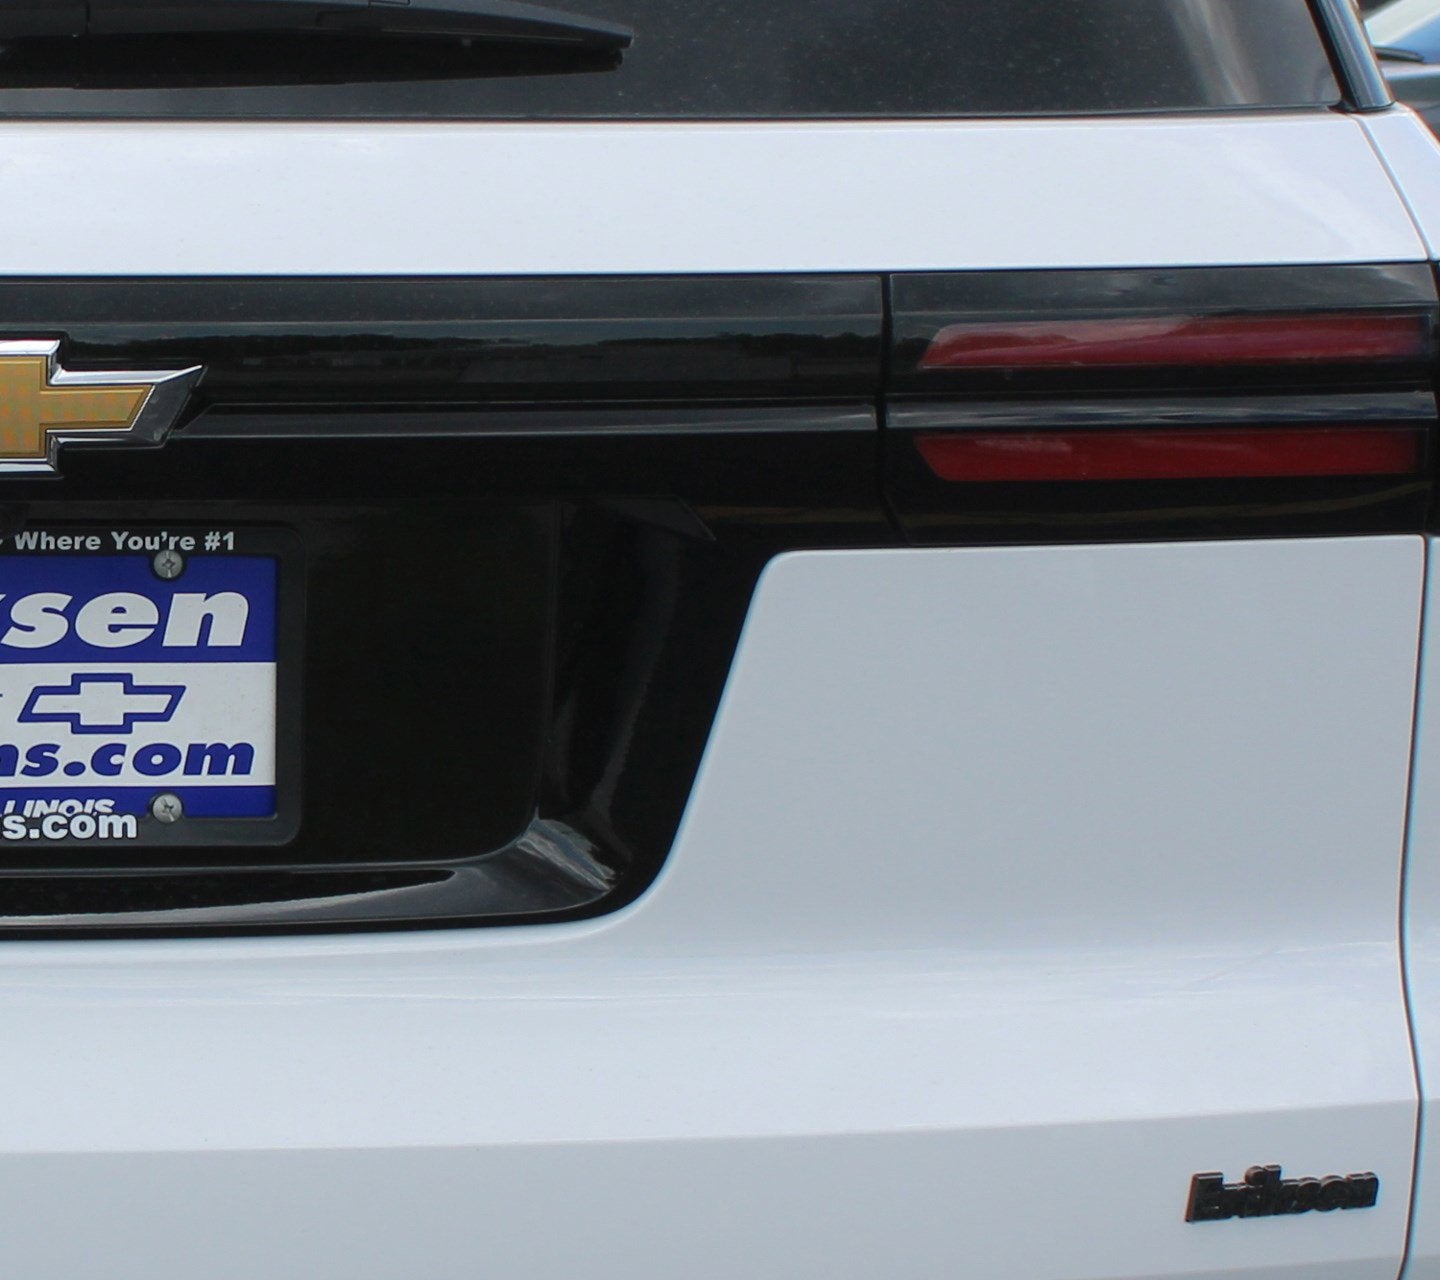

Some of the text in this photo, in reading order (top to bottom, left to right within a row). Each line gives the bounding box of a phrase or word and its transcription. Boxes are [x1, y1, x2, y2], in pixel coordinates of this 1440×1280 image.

[14, 531, 102, 551] Where
[111, 531, 196, 551] You're
[204, 531, 234, 551] #1
